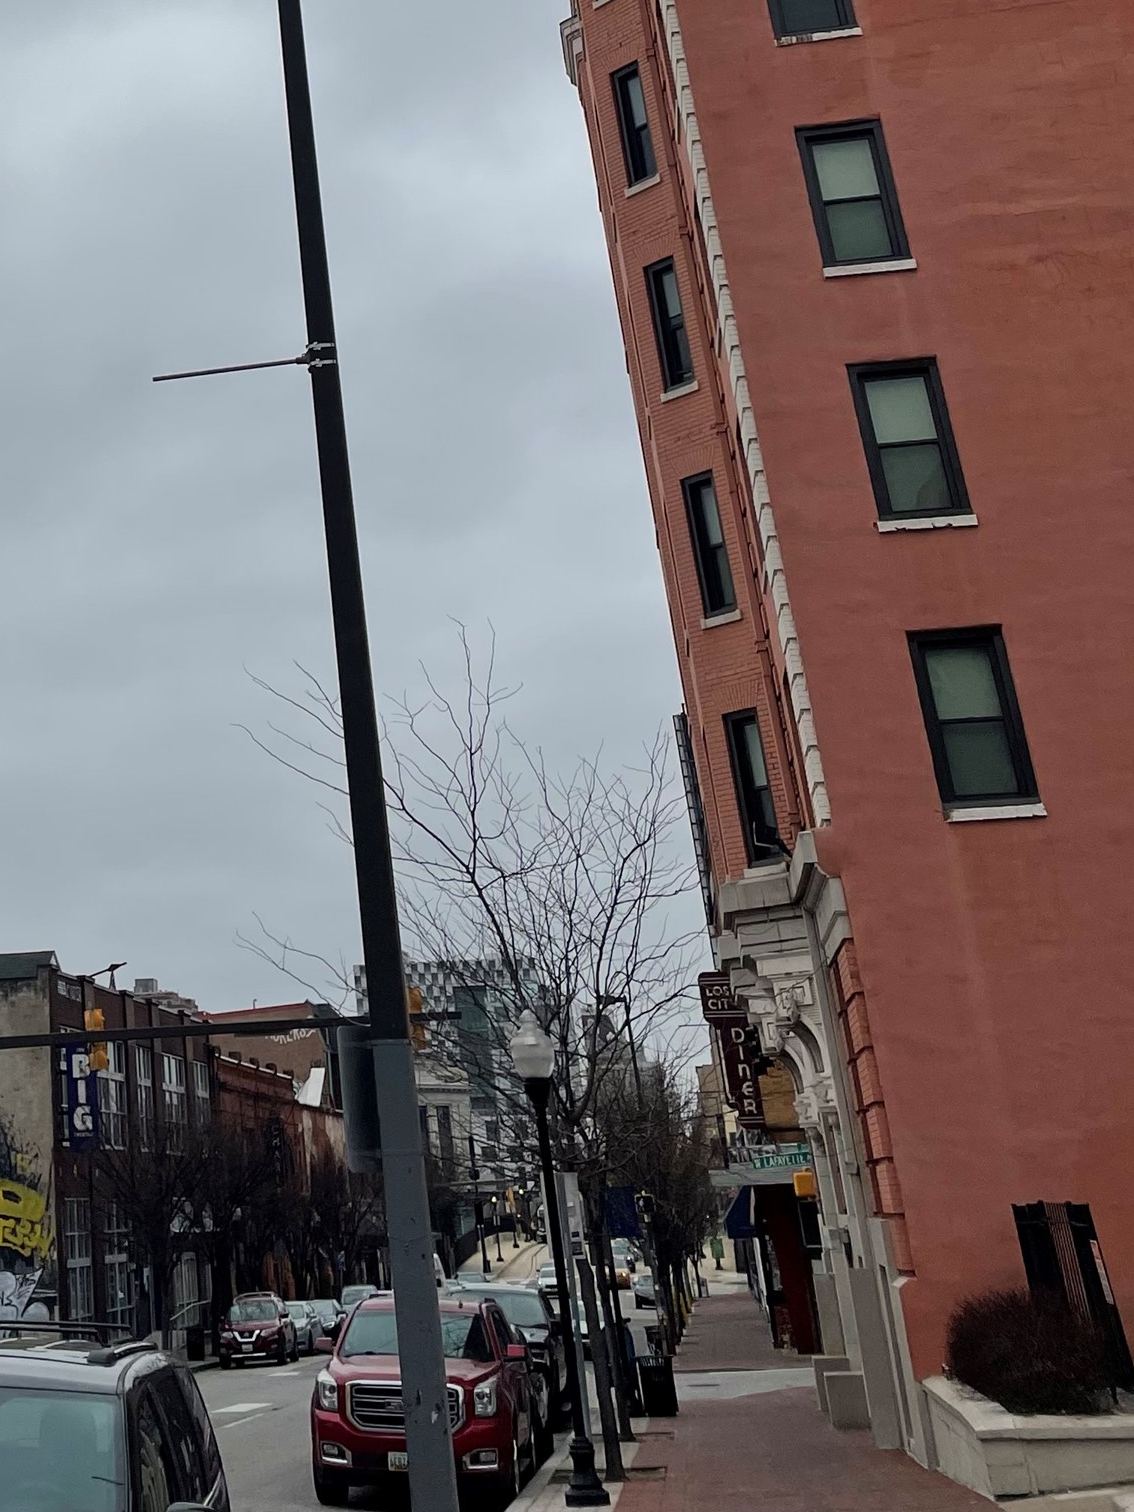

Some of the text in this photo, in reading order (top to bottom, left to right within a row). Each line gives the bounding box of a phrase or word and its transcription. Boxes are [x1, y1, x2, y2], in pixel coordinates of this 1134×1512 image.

[705, 985, 730, 997] LOS
[707, 998, 730, 1010] CIT
[72, 1053, 94, 1131] BIG
[764, 1154, 807, 1168] LAFAYETTE
